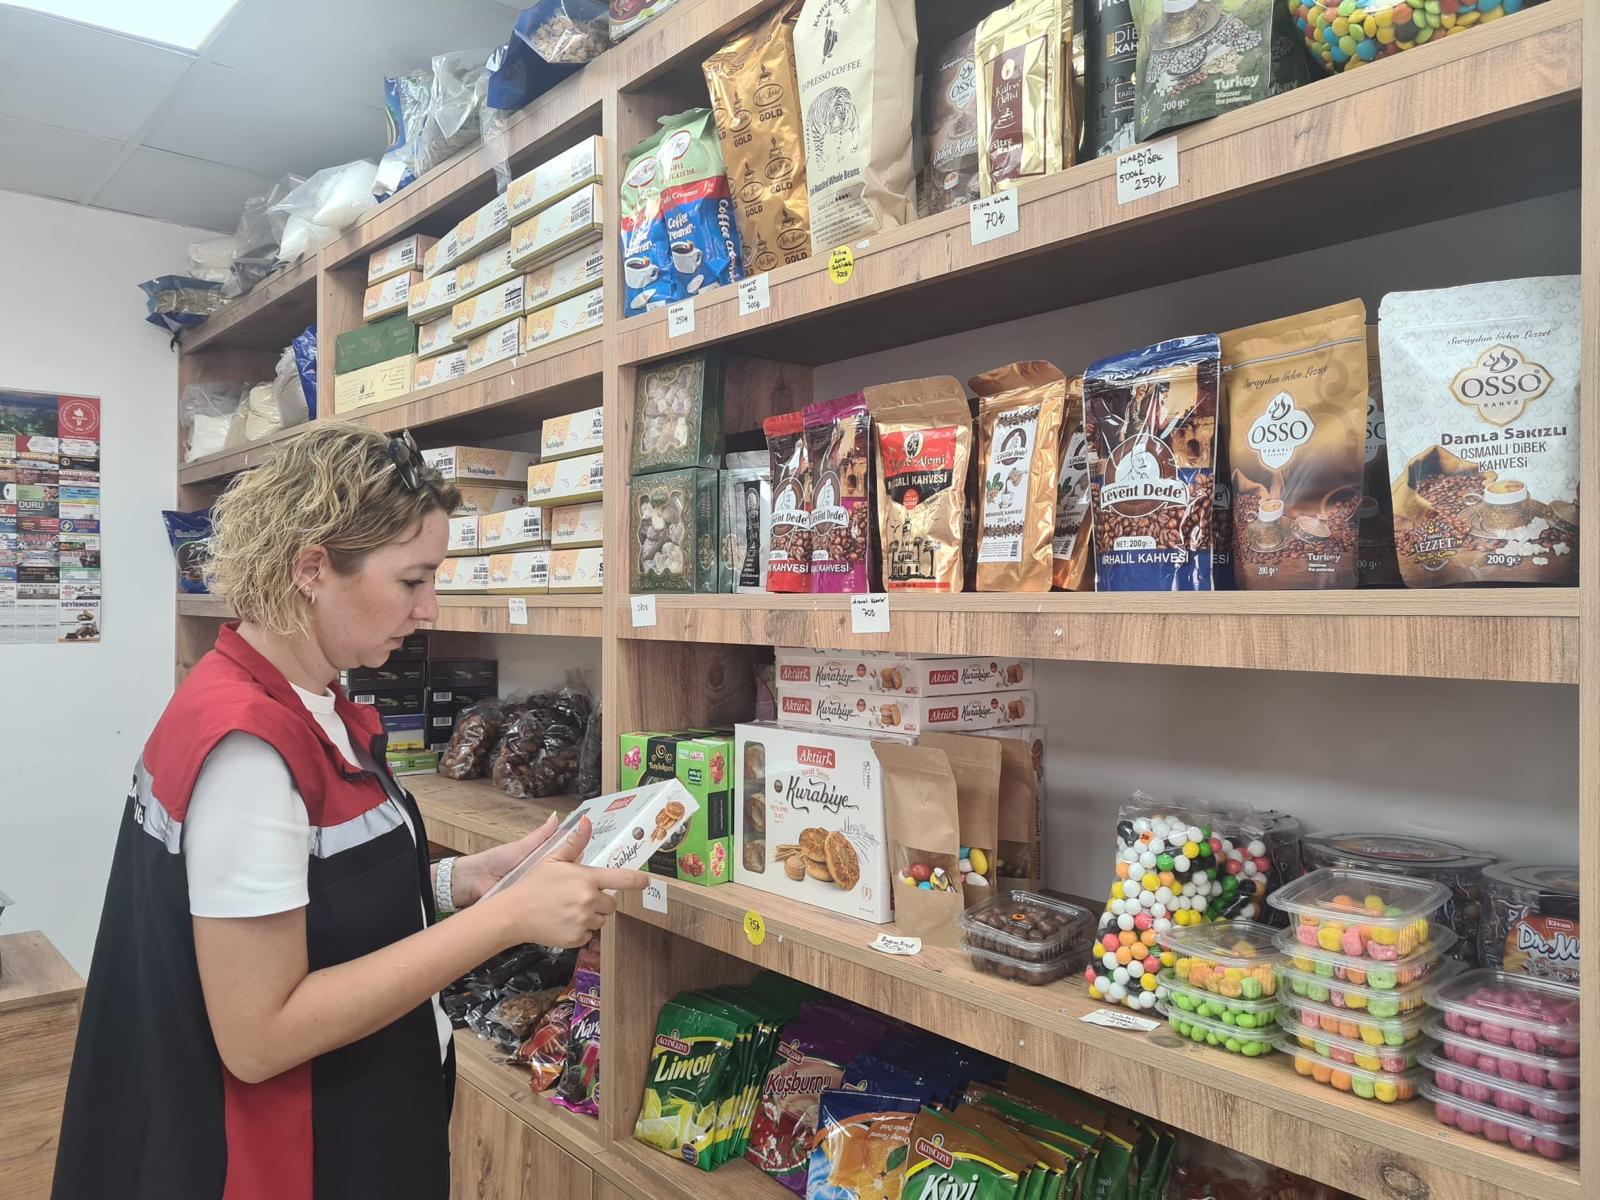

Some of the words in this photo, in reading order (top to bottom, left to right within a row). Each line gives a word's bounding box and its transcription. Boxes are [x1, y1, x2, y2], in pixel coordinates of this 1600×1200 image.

[831, 59, 862, 77] COFFEE
[1214, 74, 1260, 90] Turkey
[1216, 90, 1240, 98] Discover
[1162, 101, 1176, 112] 200
[760, 108, 783, 122] GOLD
[734, 134, 752, 148] GOLD
[844, 167, 860, 180] Beans
[770, 182, 792, 194] GOLD
[746, 204, 763, 218] GOLD
[668, 212, 688, 229] Coffee
[670, 223, 694, 241] reamer
[784, 252, 808, 264] GOLD
[1461, 373, 1542, 398] OSSO
[1252, 420, 1308, 444] OSSO
[1460, 443, 1508, 460] OSMANLI
[912, 472, 948, 485] KAHVESİ
[1102, 485, 1139, 504] Levent
[1144, 484, 1182, 499] Dede
[18, 501, 44, 509] DURU
[786, 512, 807, 524] Dede
[826, 507, 844, 522] Dede
[1415, 538, 1454, 553] LEZZET
[1138, 552, 1189, 564] KAHVESİ
[1308, 553, 1340, 563] Turkey
[1488, 556, 1504, 564] 200
[773, 563, 809, 574] KAHVESİ
[818, 563, 850, 574] KAHVESİ
[1258, 566, 1268, 576] 200
[782, 668, 809, 680] Aktürk
[816, 666, 858, 688] Kurabiye
[930, 672, 956, 683] Aktürk
[961, 668, 994, 685] Kurabiye
[784, 700, 810, 712] Aktürk
[816, 698, 858, 722] Kurabiye
[930, 710, 956, 722] Aktürk
[962, 705, 996, 722] Kurabiye
[800, 749, 833, 766] Aktürk
[786, 775, 860, 814] Kurabiye
[1548, 920, 1571, 929] Elvan
[654, 1052, 716, 1083] Limon
[766, 1072, 832, 1097] Kuşburnu
[918, 1172, 980, 1200] Kivi
